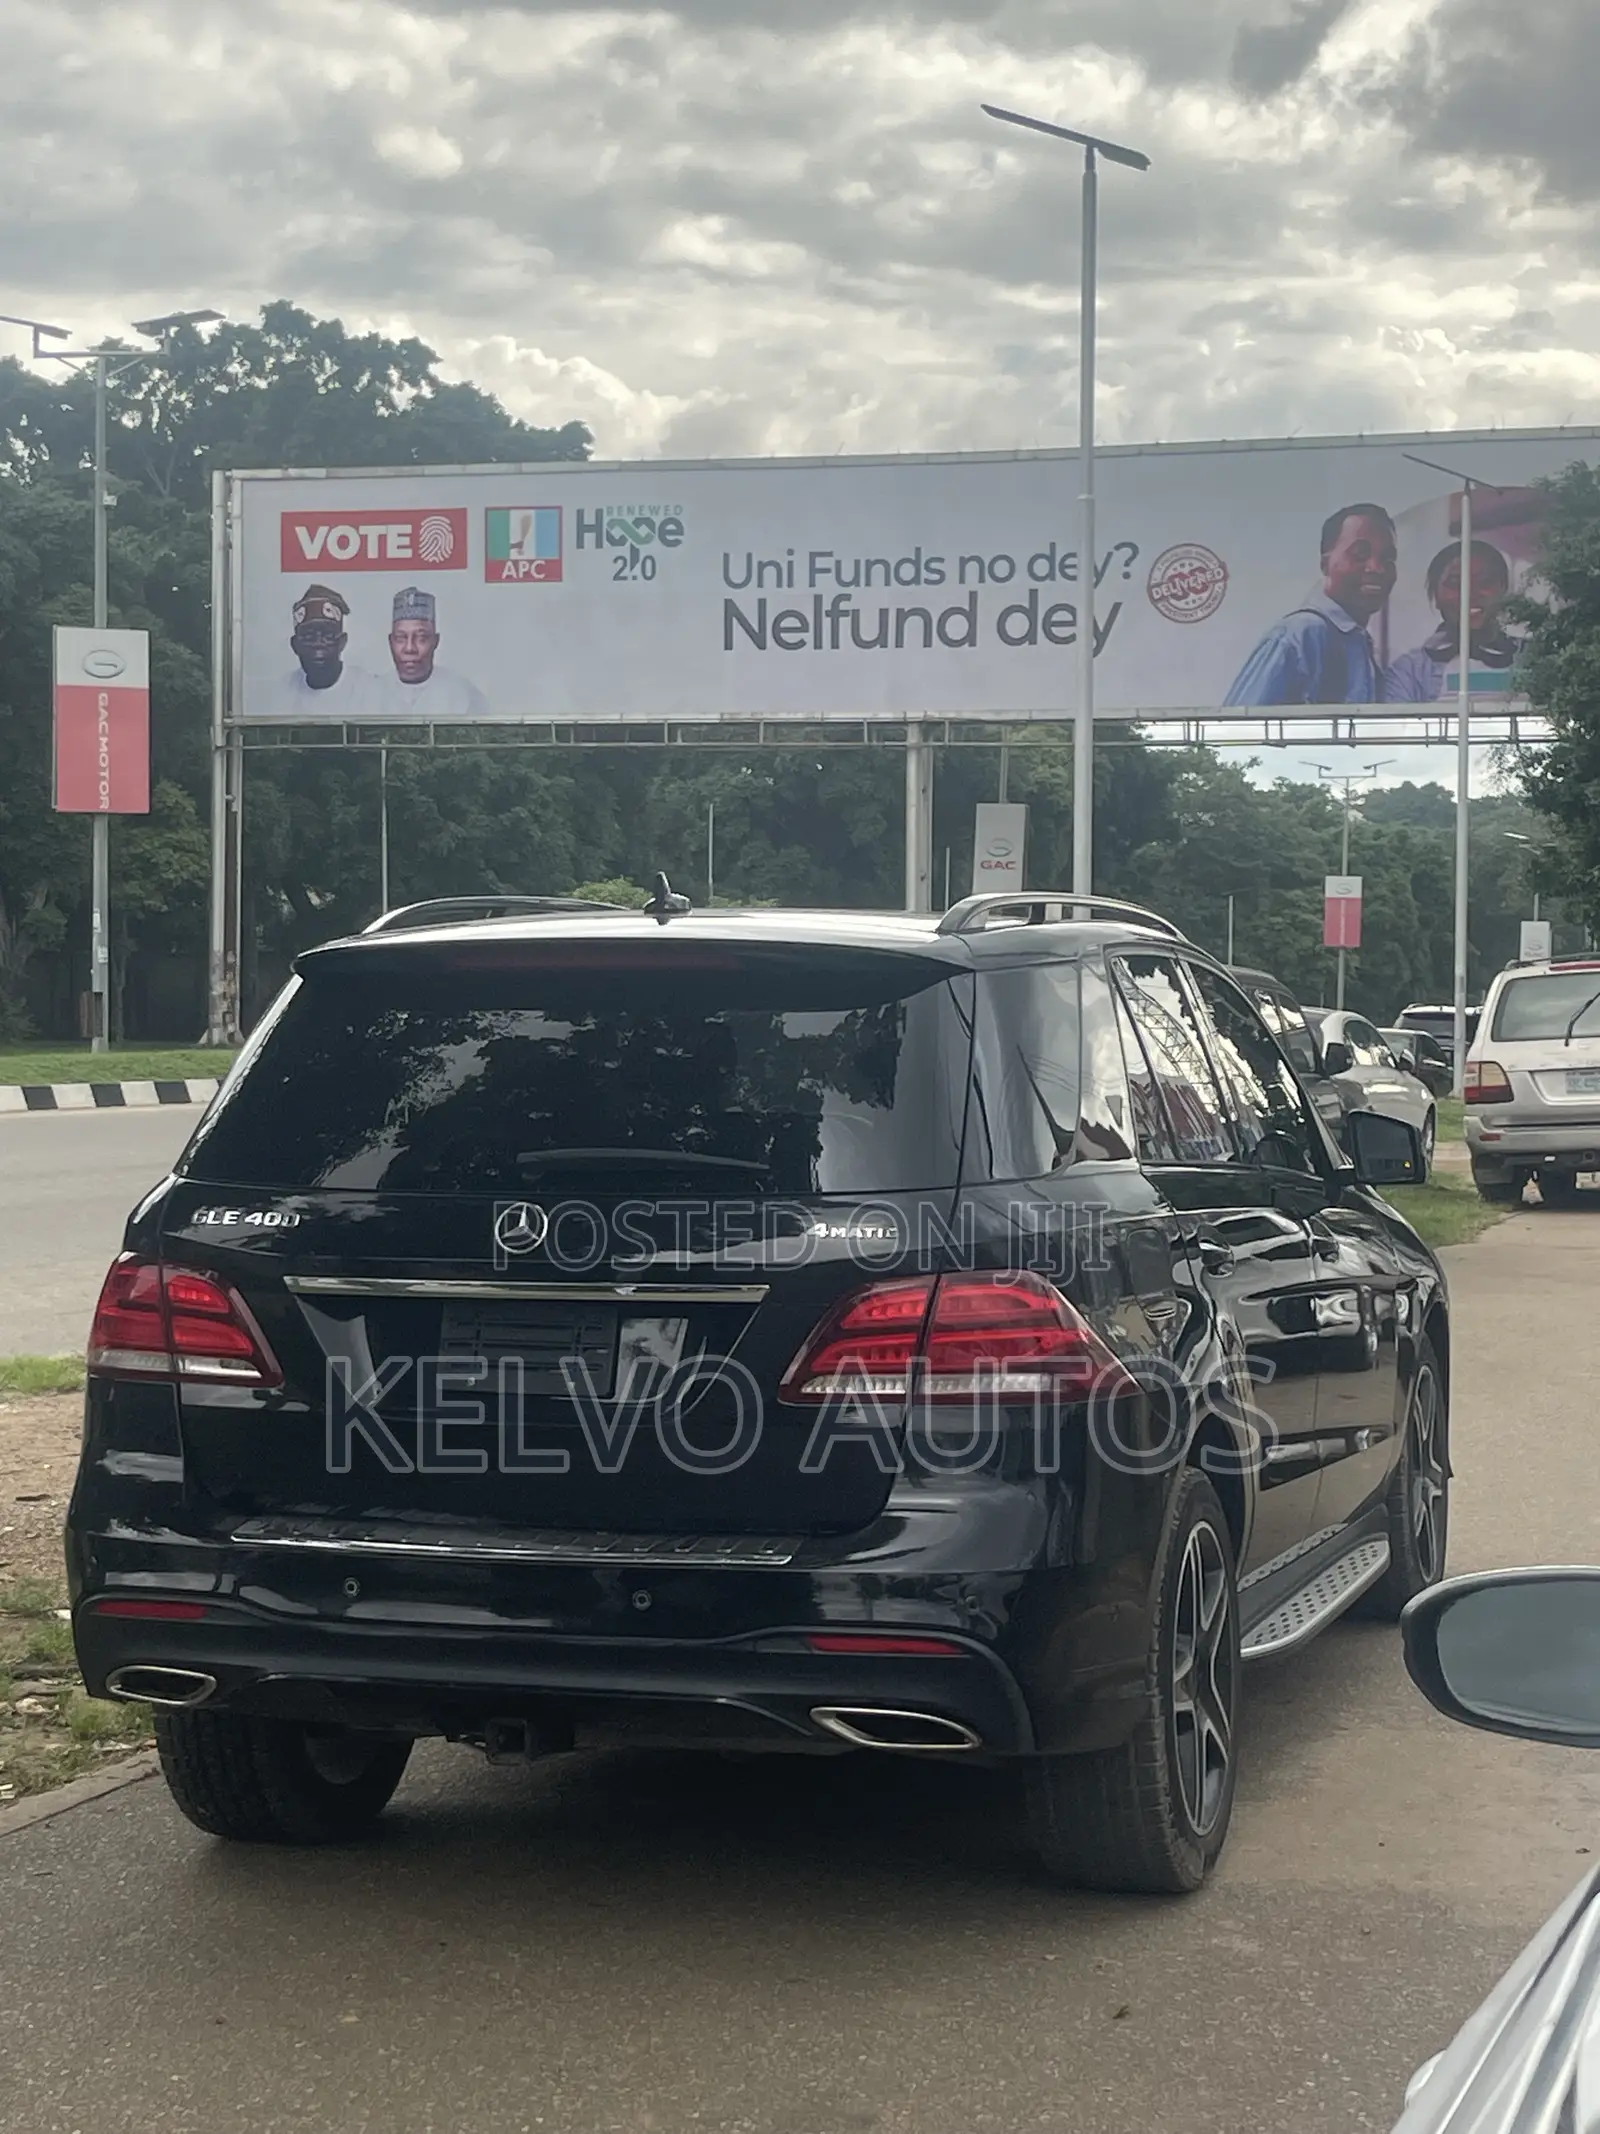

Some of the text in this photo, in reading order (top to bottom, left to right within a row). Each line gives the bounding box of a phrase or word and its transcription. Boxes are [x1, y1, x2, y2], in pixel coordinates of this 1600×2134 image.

[606, 504, 684, 517] RENEWED
[294, 523, 413, 561] VOTE
[576, 507, 685, 572] Hope
[501, 559, 547, 580] APC
[612, 554, 657, 581] 2.0
[722, 548, 795, 589] Uni
[808, 546, 946, 588] Funds
[958, 551, 1017, 586] no
[1027, 541, 1140, 590] dey?
[1151, 566, 1225, 601] DELIVERED
[722, 590, 978, 651] Nelfund
[996, 588, 1124, 659] dey
[98, 736, 111, 810] MOTOR
[980, 860, 1017, 870] GAC
[191, 1206, 301, 1228] GLE 400
[806, 1222, 899, 1239] 4MATIC
